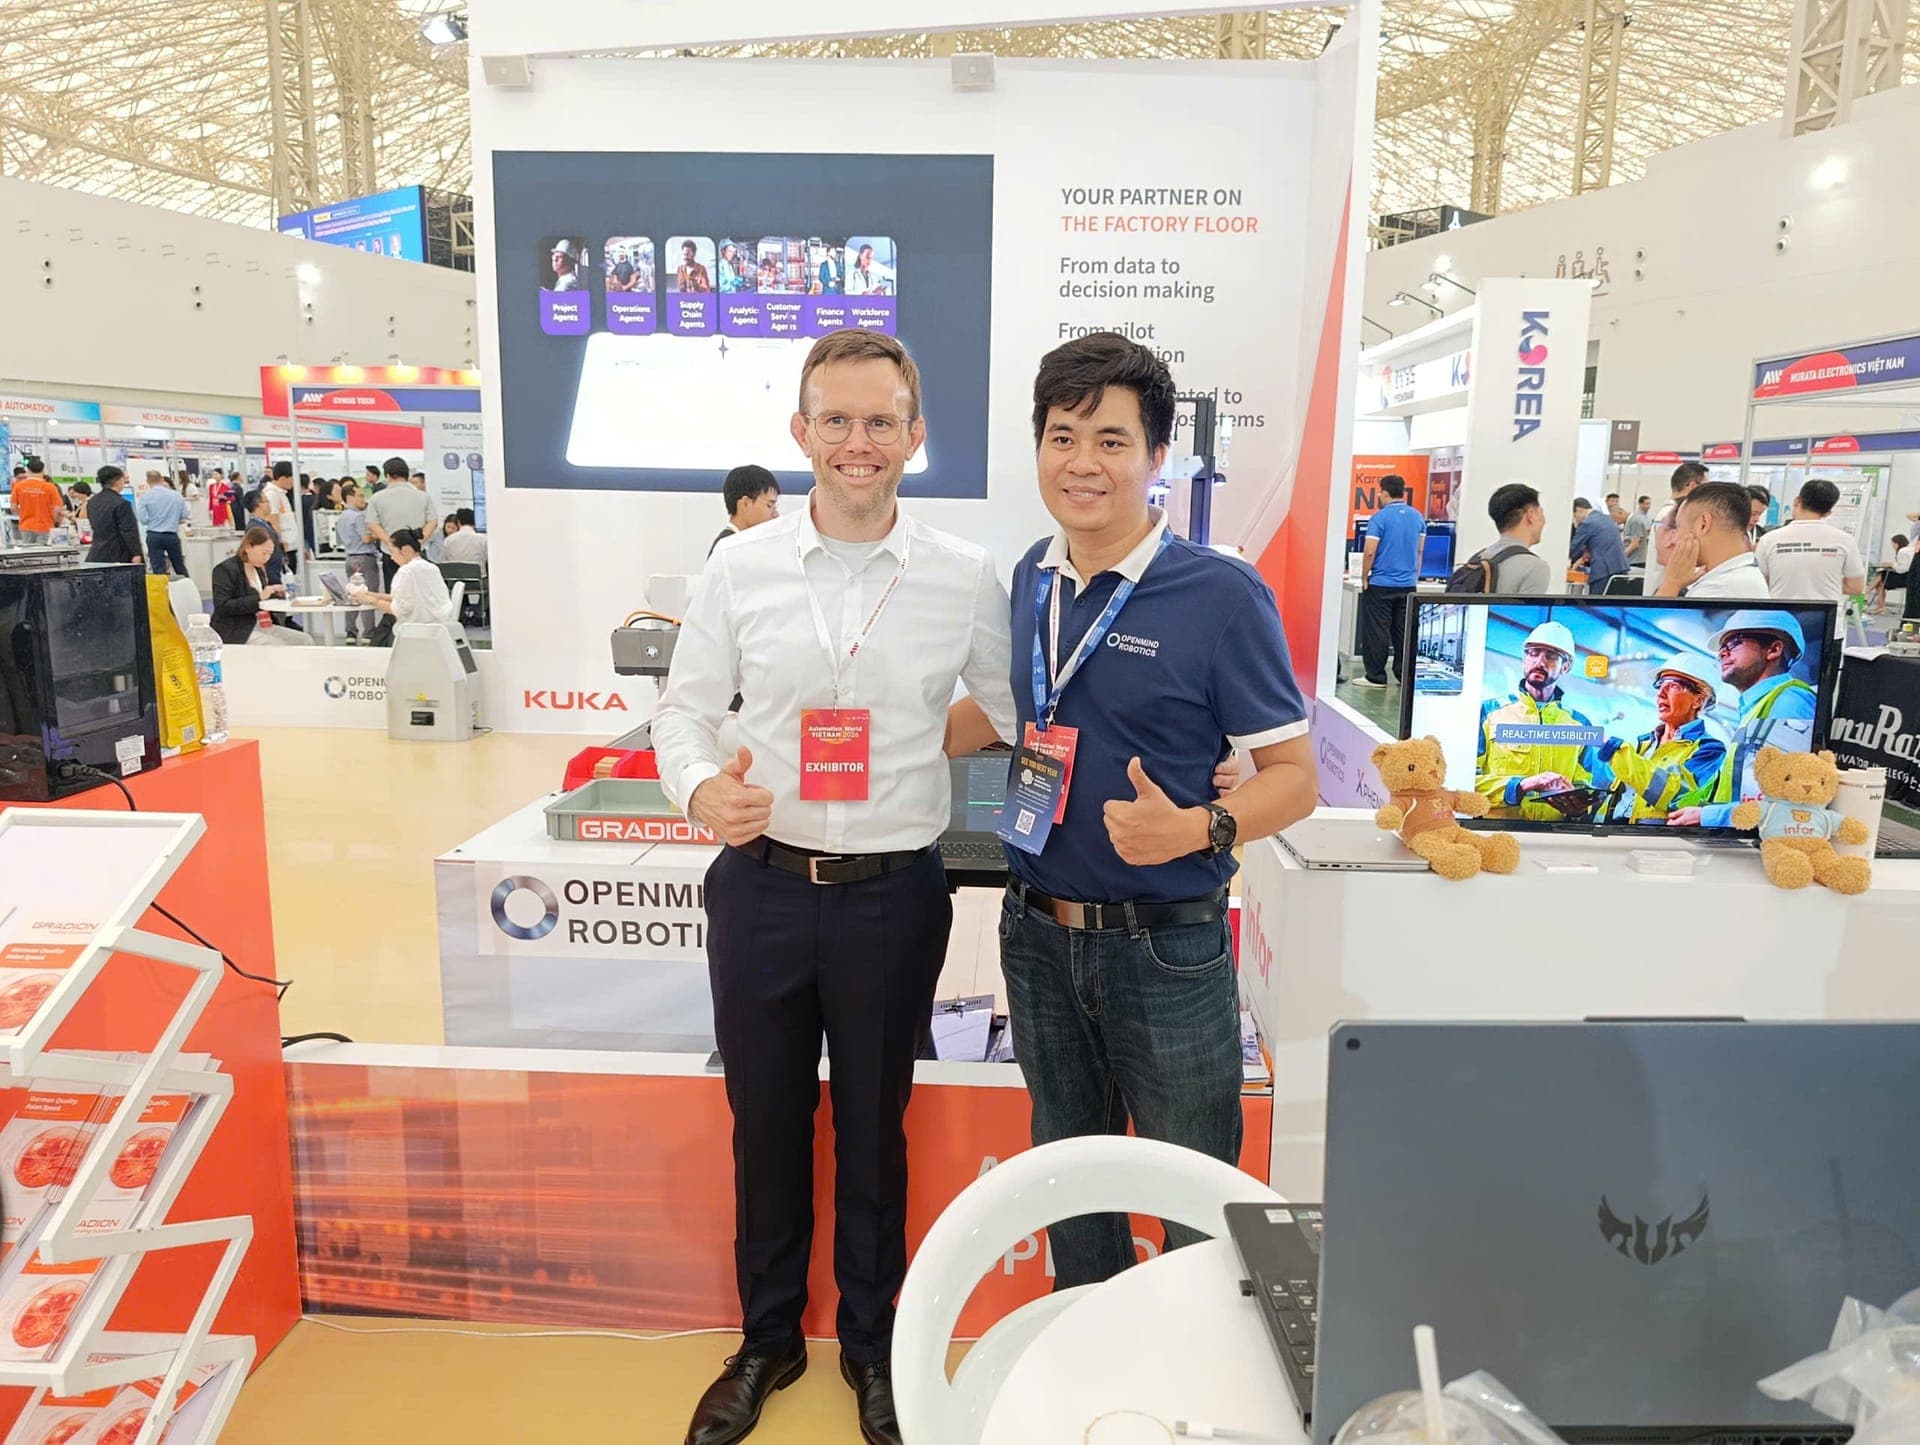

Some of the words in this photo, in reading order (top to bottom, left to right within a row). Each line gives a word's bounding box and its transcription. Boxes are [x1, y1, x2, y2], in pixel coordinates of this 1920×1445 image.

[1061, 188, 1114, 205] YOUR
[1120, 188, 1208, 205] PARTNER
[1213, 189, 1242, 206] ON
[1061, 215, 1098, 232] THE
[1104, 216, 1189, 232] FACTORY
[1194, 216, 1258, 232] FLOOR
[1060, 257, 1108, 274] From
[1113, 256, 1155, 274] data
[1161, 258, 1180, 274] to
[1059, 280, 1137, 298] decision
[1143, 281, 1215, 303] making
[552, 304, 578, 313] Project
[612, 305, 651, 314] Operations
[679, 301, 704, 311] Supply
[816, 307, 845, 316] Finance
[851, 308, 890, 316] Workforce
[553, 313, 579, 322] Agents
[619, 314, 644, 323] Agents
[681, 310, 703, 319] Chain
[679, 320, 705, 329] Agents
[817, 317, 844, 326] Agents
[857, 318, 884, 326] Agents
[1790, 368, 1817, 383] MURATA
[1817, 361, 1867, 379] ELECTRONICS
[1885, 356, 1905, 370] NAM
[1512, 311, 1550, 443] KOREA
[1224, 388, 1243, 404] to
[1121, 635, 1160, 648] OPENMIND
[1118, 643, 1156, 657] ROBOTICS
[524, 690, 628, 711] KUKA
[1502, 729, 1551, 739] REAL-TIME
[1552, 731, 1598, 741] VISIBILITY
[805, 762, 864, 773] EXHIBITOR
[580, 819, 714, 841] GRADION
[1784, 824, 1815, 836] infor
[568, 918, 703, 949] ROBOTI
